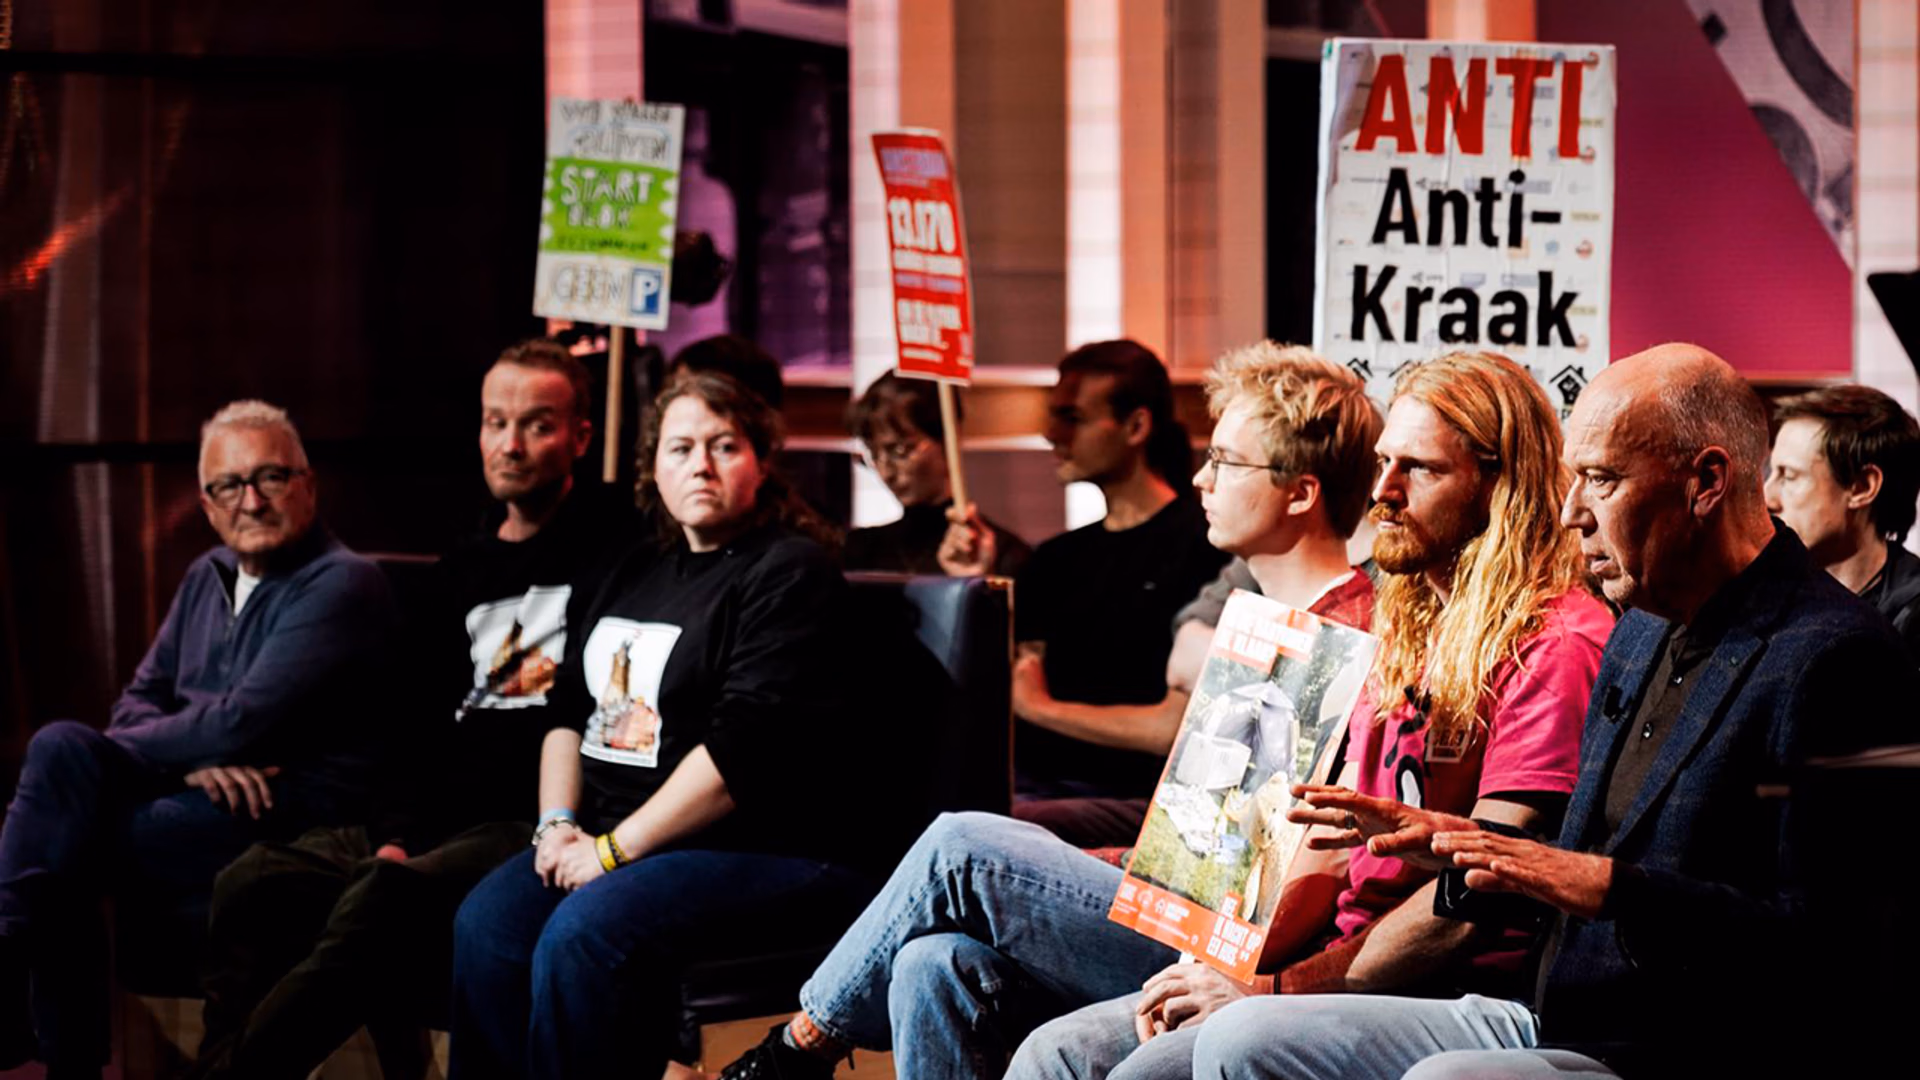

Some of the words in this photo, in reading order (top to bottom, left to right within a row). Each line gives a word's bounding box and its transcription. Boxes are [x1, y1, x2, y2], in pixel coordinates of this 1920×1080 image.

[1354, 54, 1584, 159] ANTI
[560, 165, 655, 206] START
[1370, 168, 1562, 249] Anti-
[632, 271, 660, 312] P
[1350, 265, 1579, 347] Kraak
